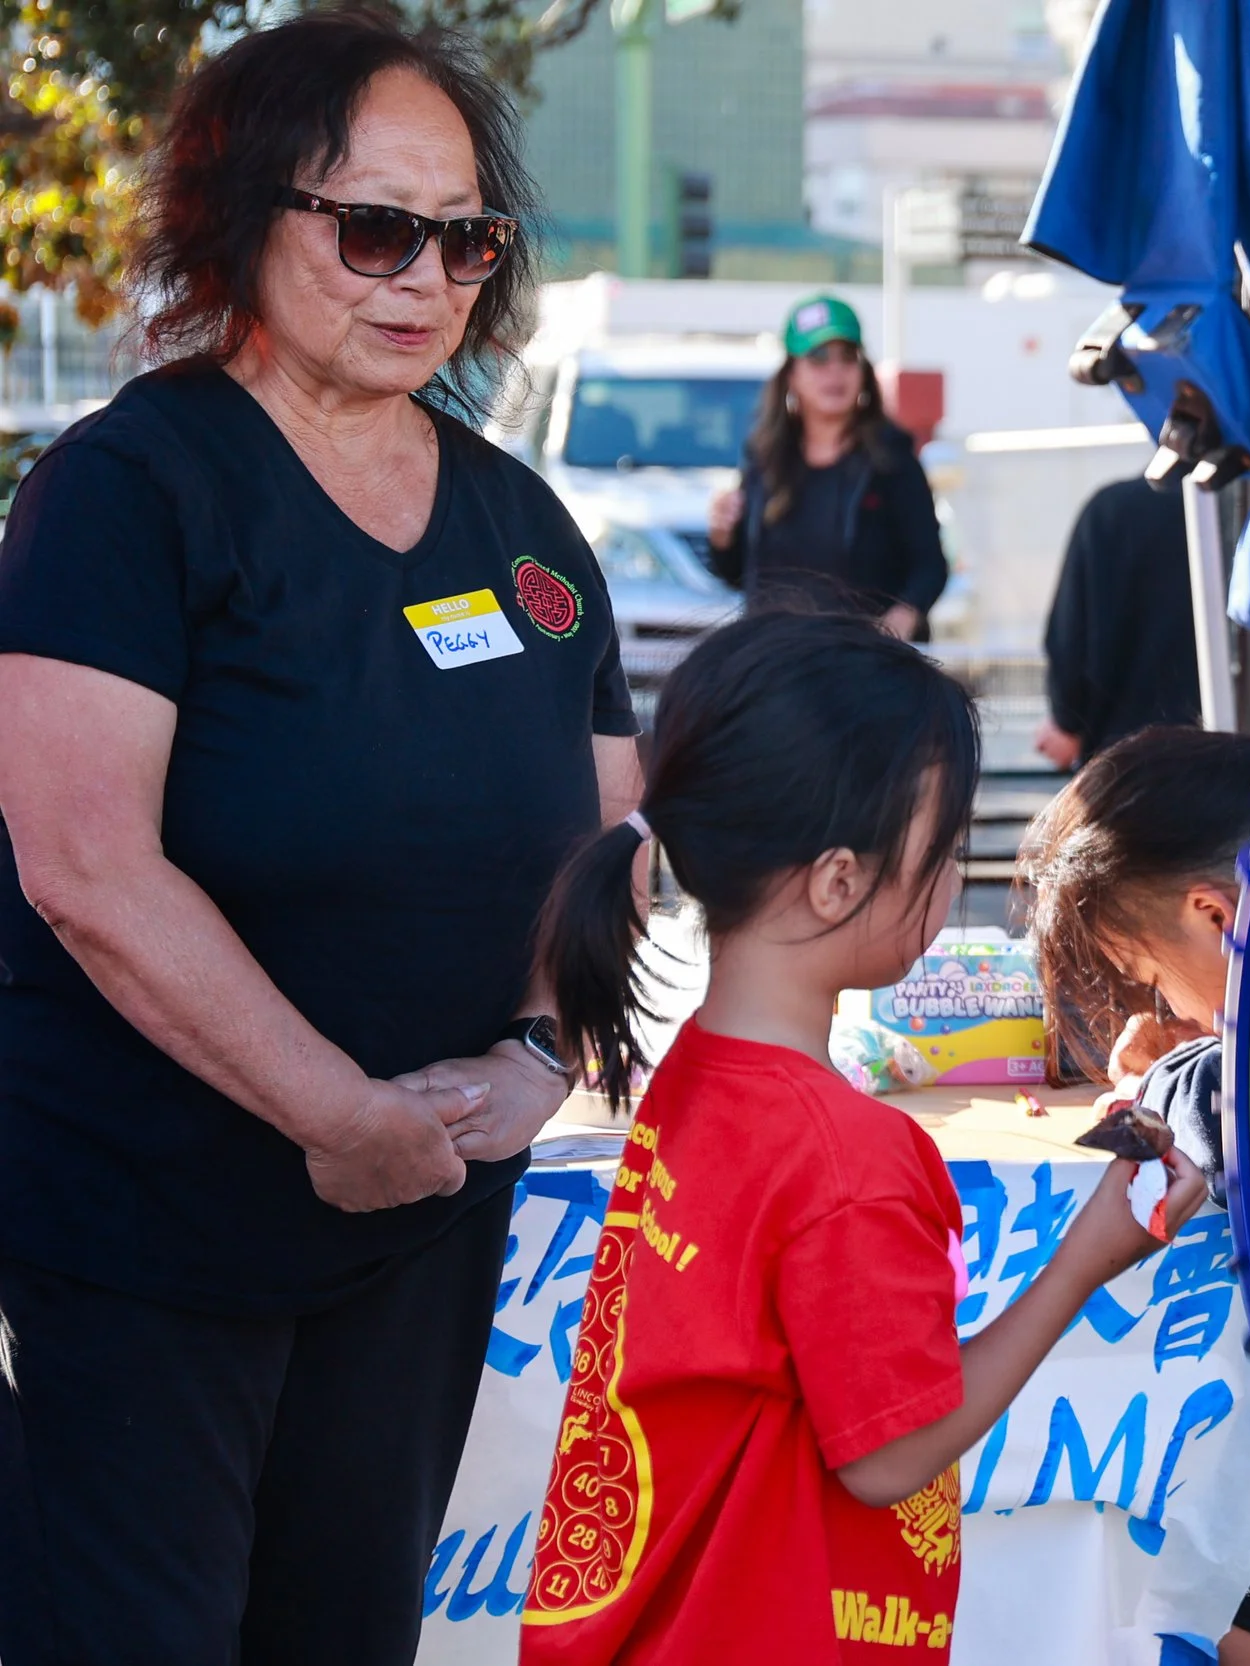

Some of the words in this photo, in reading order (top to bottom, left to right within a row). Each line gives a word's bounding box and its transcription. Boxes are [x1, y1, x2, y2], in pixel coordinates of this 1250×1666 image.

[550, 570, 578, 595] Methodist
[574, 593, 585, 616] Church
[431, 598, 470, 616] HELLO
[426, 630, 491, 655] PEGGY
[893, 996, 980, 1018] BUBBLE
[598, 1243, 612, 1266] 1
[572, 1385, 602, 1406] LINCO
[573, 1472, 600, 1498] 40
[605, 1496, 619, 1518] 8
[567, 1523, 598, 1551] 28
[545, 1573, 571, 1599] 11
